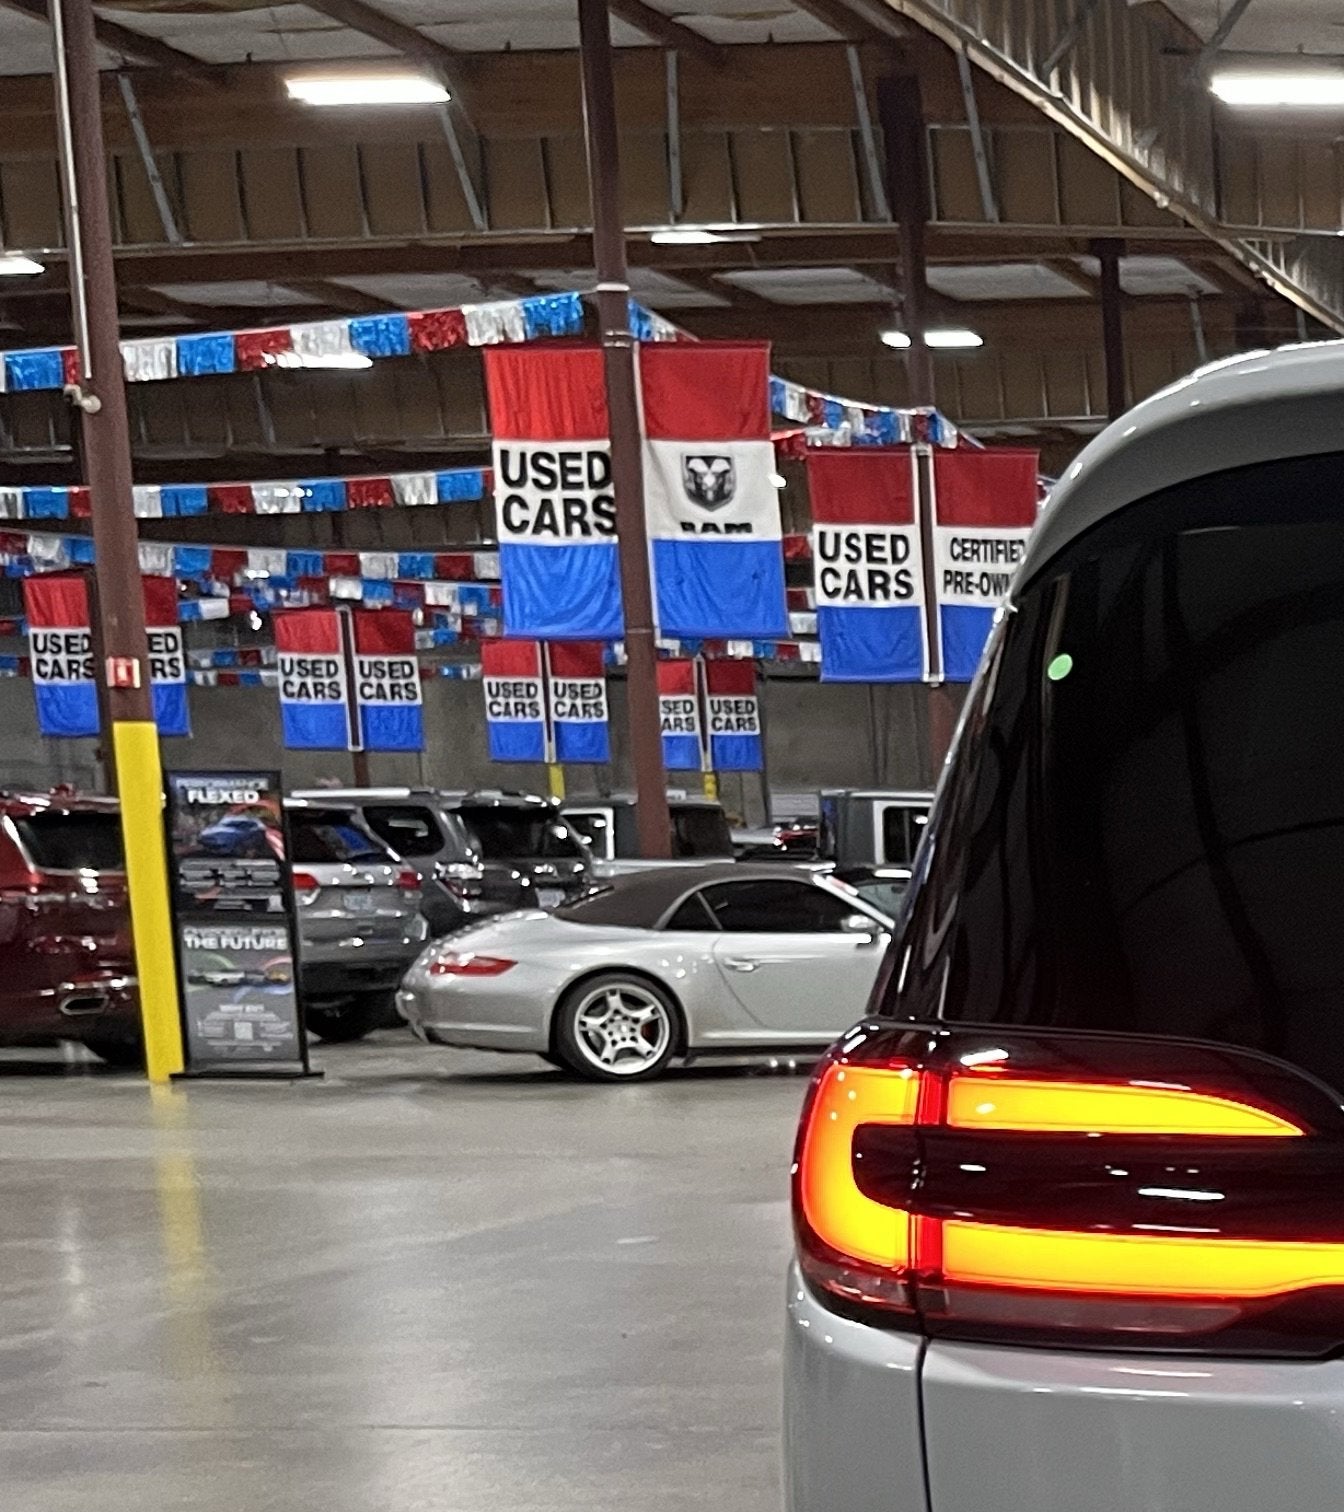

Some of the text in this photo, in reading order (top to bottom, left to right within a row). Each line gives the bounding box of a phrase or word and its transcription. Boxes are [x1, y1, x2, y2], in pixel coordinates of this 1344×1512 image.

[500, 449, 611, 491] USED
[502, 494, 616, 537] CARS
[818, 531, 910, 565] USED
[820, 566, 915, 601] CARS
[36, 658, 95, 680] CARS
[280, 659, 339, 679] USED
[358, 660, 415, 680] USED
[282, 681, 342, 700] CARS
[360, 682, 418, 701] CARS
[487, 682, 538, 699] USED
[554, 682, 603, 700] USED
[489, 701, 541, 718] CARS
[554, 701, 605, 718] CARS
[661, 699, 694, 715] SED
[710, 699, 755, 715] USED
[662, 717, 696, 732] ARS
[711, 717, 758, 733] CARS
[187, 790, 260, 804] FLEXED
[184, 936, 288, 951] THE FUTURE
